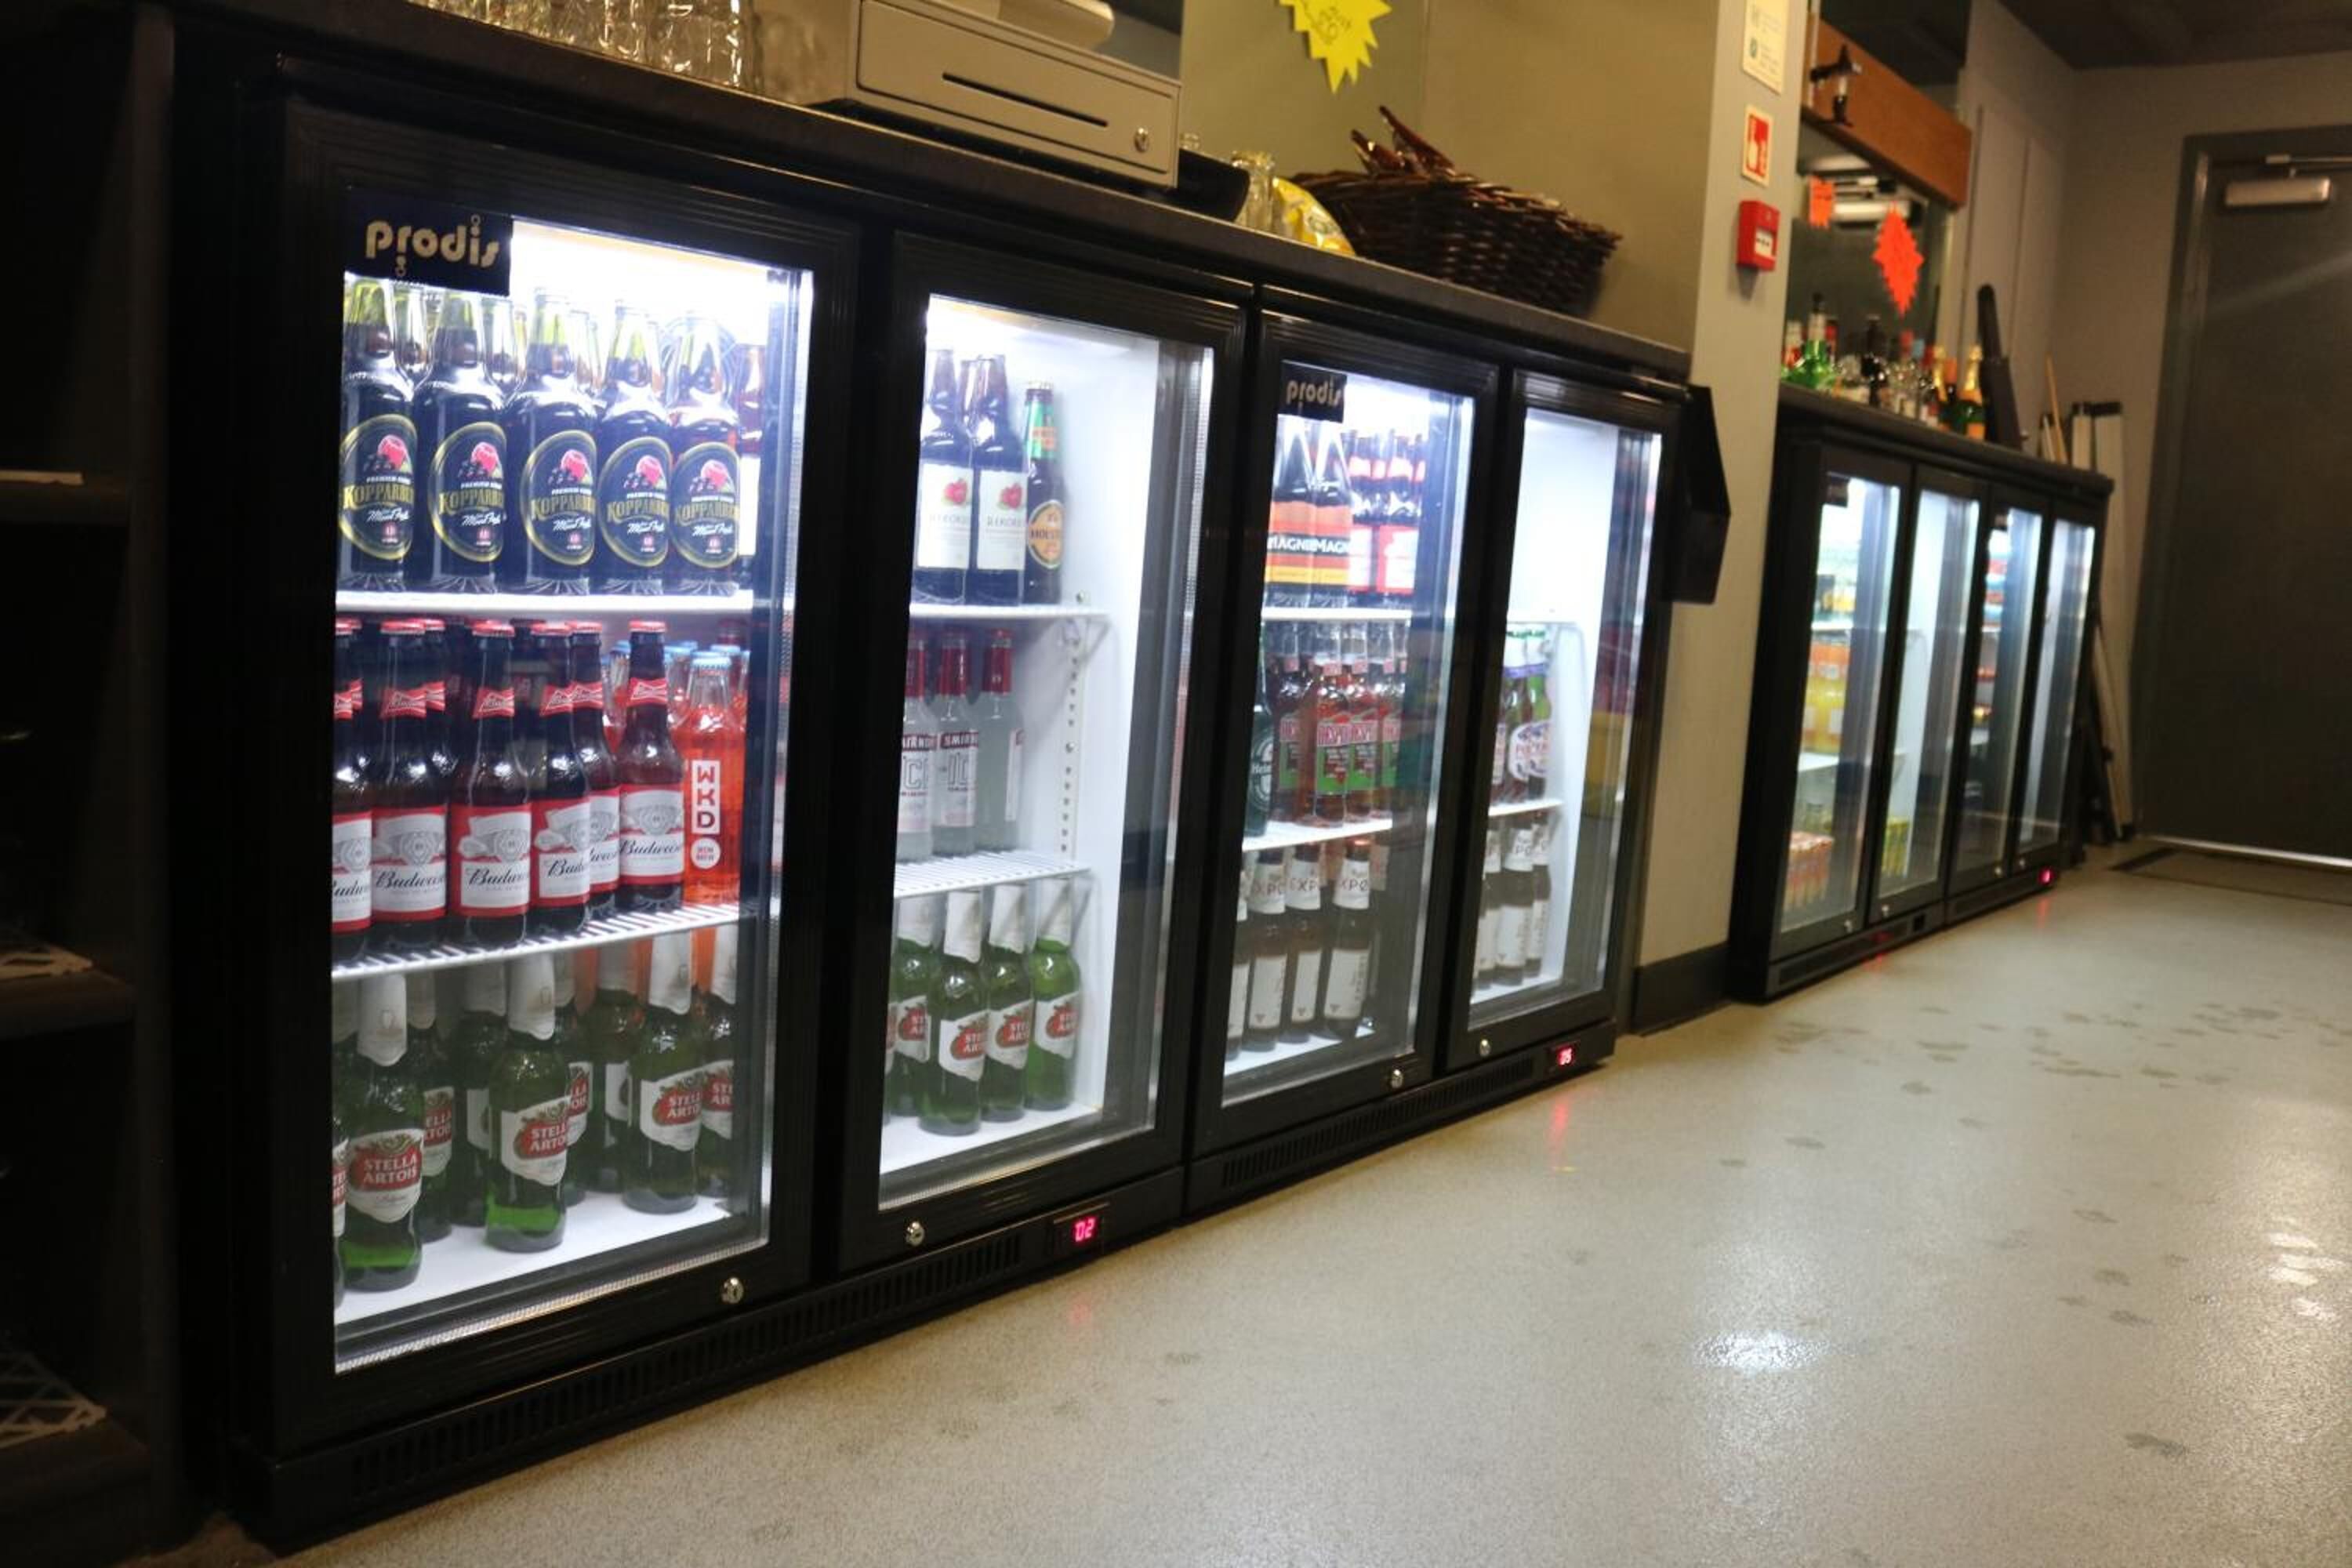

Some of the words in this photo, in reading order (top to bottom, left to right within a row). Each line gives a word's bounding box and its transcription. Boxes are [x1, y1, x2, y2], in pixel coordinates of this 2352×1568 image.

[365, 215, 499, 276] prodis
[1287, 376, 1341, 412] prodis
[697, 766, 715, 829] WKD
[363, 1166, 417, 1184] ARTOIS
[364, 1153, 418, 1171] STELLA
